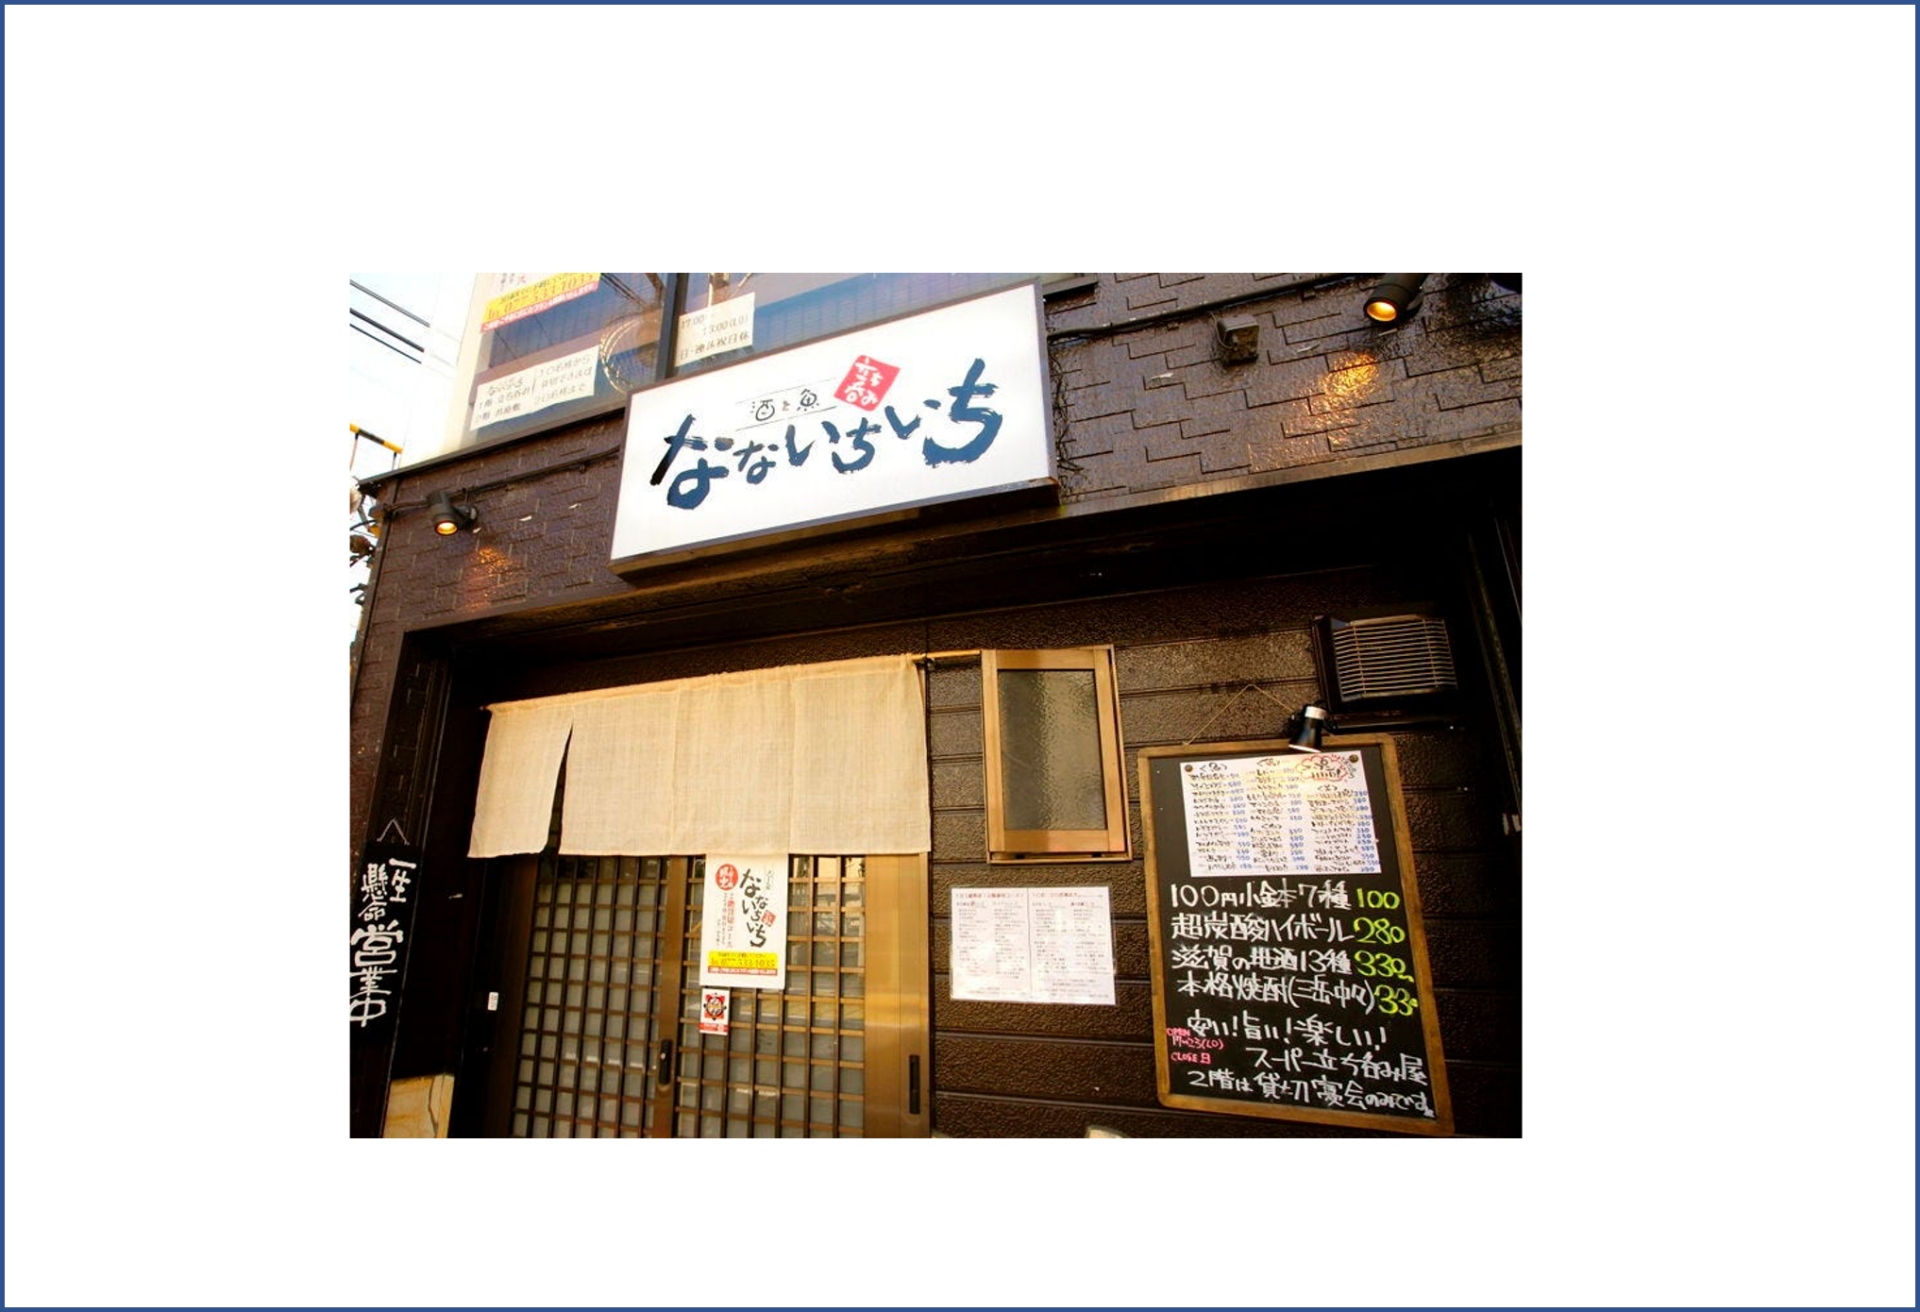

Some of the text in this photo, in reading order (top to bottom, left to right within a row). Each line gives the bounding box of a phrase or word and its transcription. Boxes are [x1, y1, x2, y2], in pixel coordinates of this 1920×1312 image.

[750, 388, 820, 421] 酒と魚
[650, 357, 1003, 510] なないちいち
[388, 857, 417, 903] 一生
[1356, 887, 1400, 910] 100
[1170, 910, 1405, 944] 超炭酸ハイボール 280
[350, 918, 404, 1028] 営業中
[1171, 944, 1352, 976] 滋賀の地酒13種
